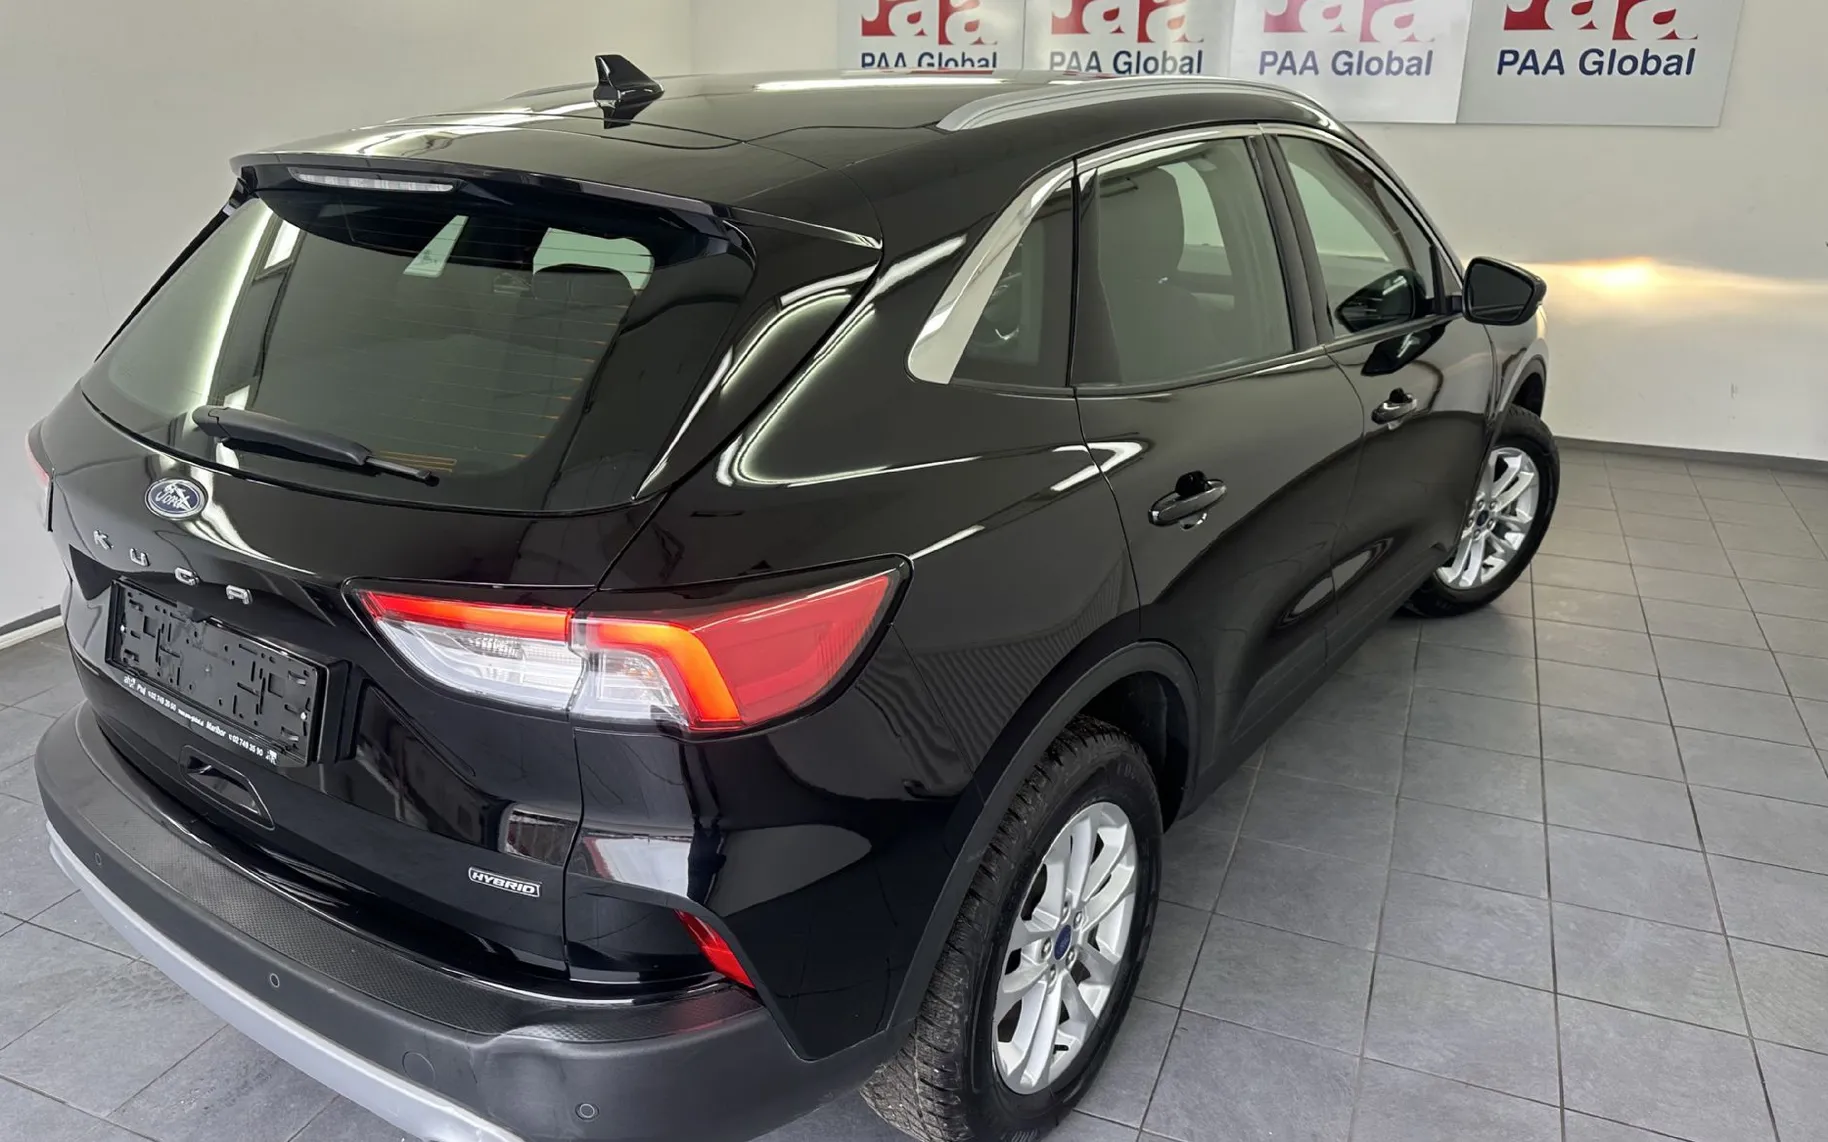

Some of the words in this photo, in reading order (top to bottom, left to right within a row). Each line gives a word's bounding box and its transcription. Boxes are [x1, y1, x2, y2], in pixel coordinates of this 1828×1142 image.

[861, 52, 907, 68] PAA
[918, 52, 997, 68] Global
[1050, 51, 1103, 73] PAA
[1113, 50, 1203, 75] Global
[1259, 50, 1320, 75] PAA
[1331, 50, 1433, 76] Global
[1497, 49, 1565, 75] PAA
[1578, 48, 1696, 76] Global
[93, 530, 252, 605] KUGA
[472, 872, 536, 895] HYBRID
